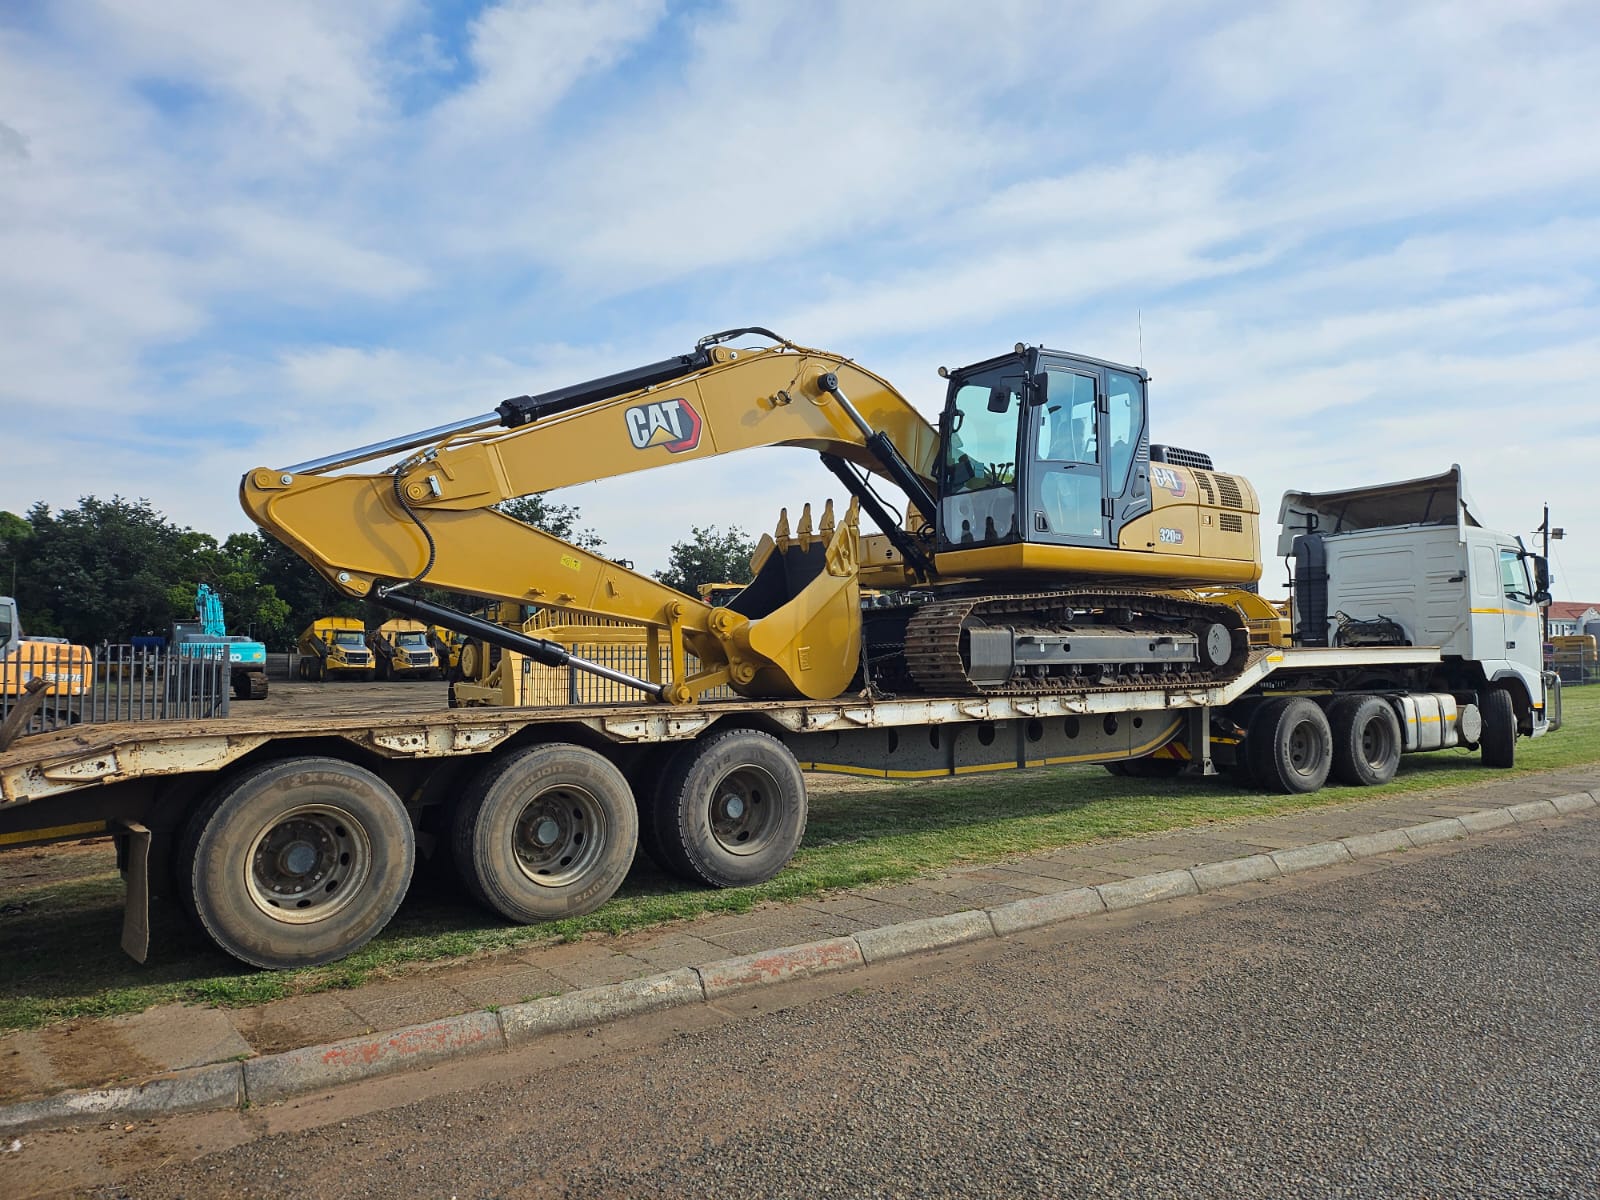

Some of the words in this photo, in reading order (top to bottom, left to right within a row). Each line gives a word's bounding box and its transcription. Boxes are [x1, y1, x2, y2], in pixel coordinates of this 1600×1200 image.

[626, 400, 683, 448] CAT
[1152, 467, 1178, 490] CAT
[1159, 526, 1175, 543] 320
